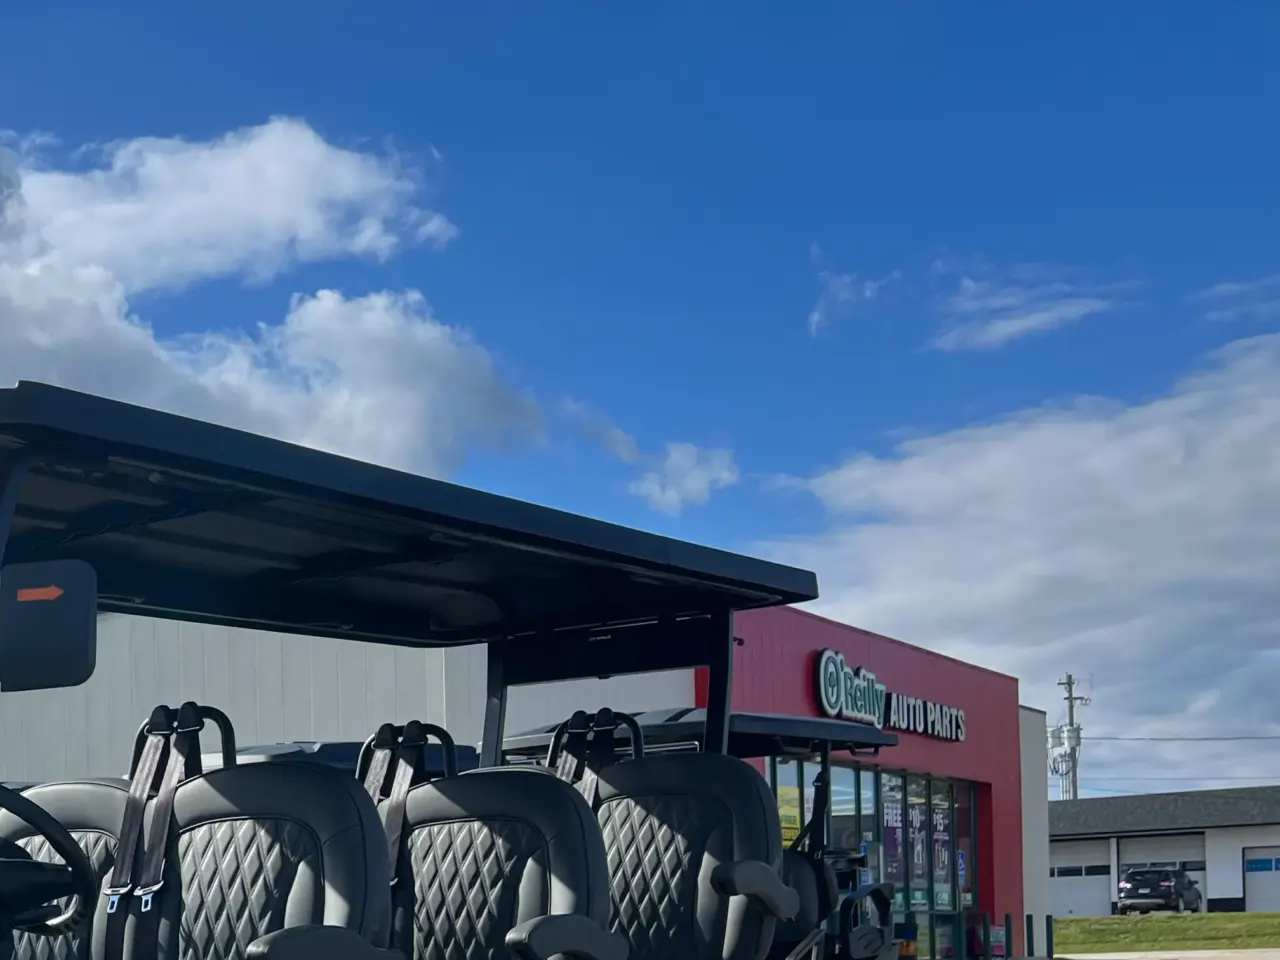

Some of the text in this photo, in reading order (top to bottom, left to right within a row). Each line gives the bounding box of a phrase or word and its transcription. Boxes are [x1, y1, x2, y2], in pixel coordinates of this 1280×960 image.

[821, 649, 966, 742] O'Reilly AUTO PARTS
[883, 808, 903, 828] FREE
